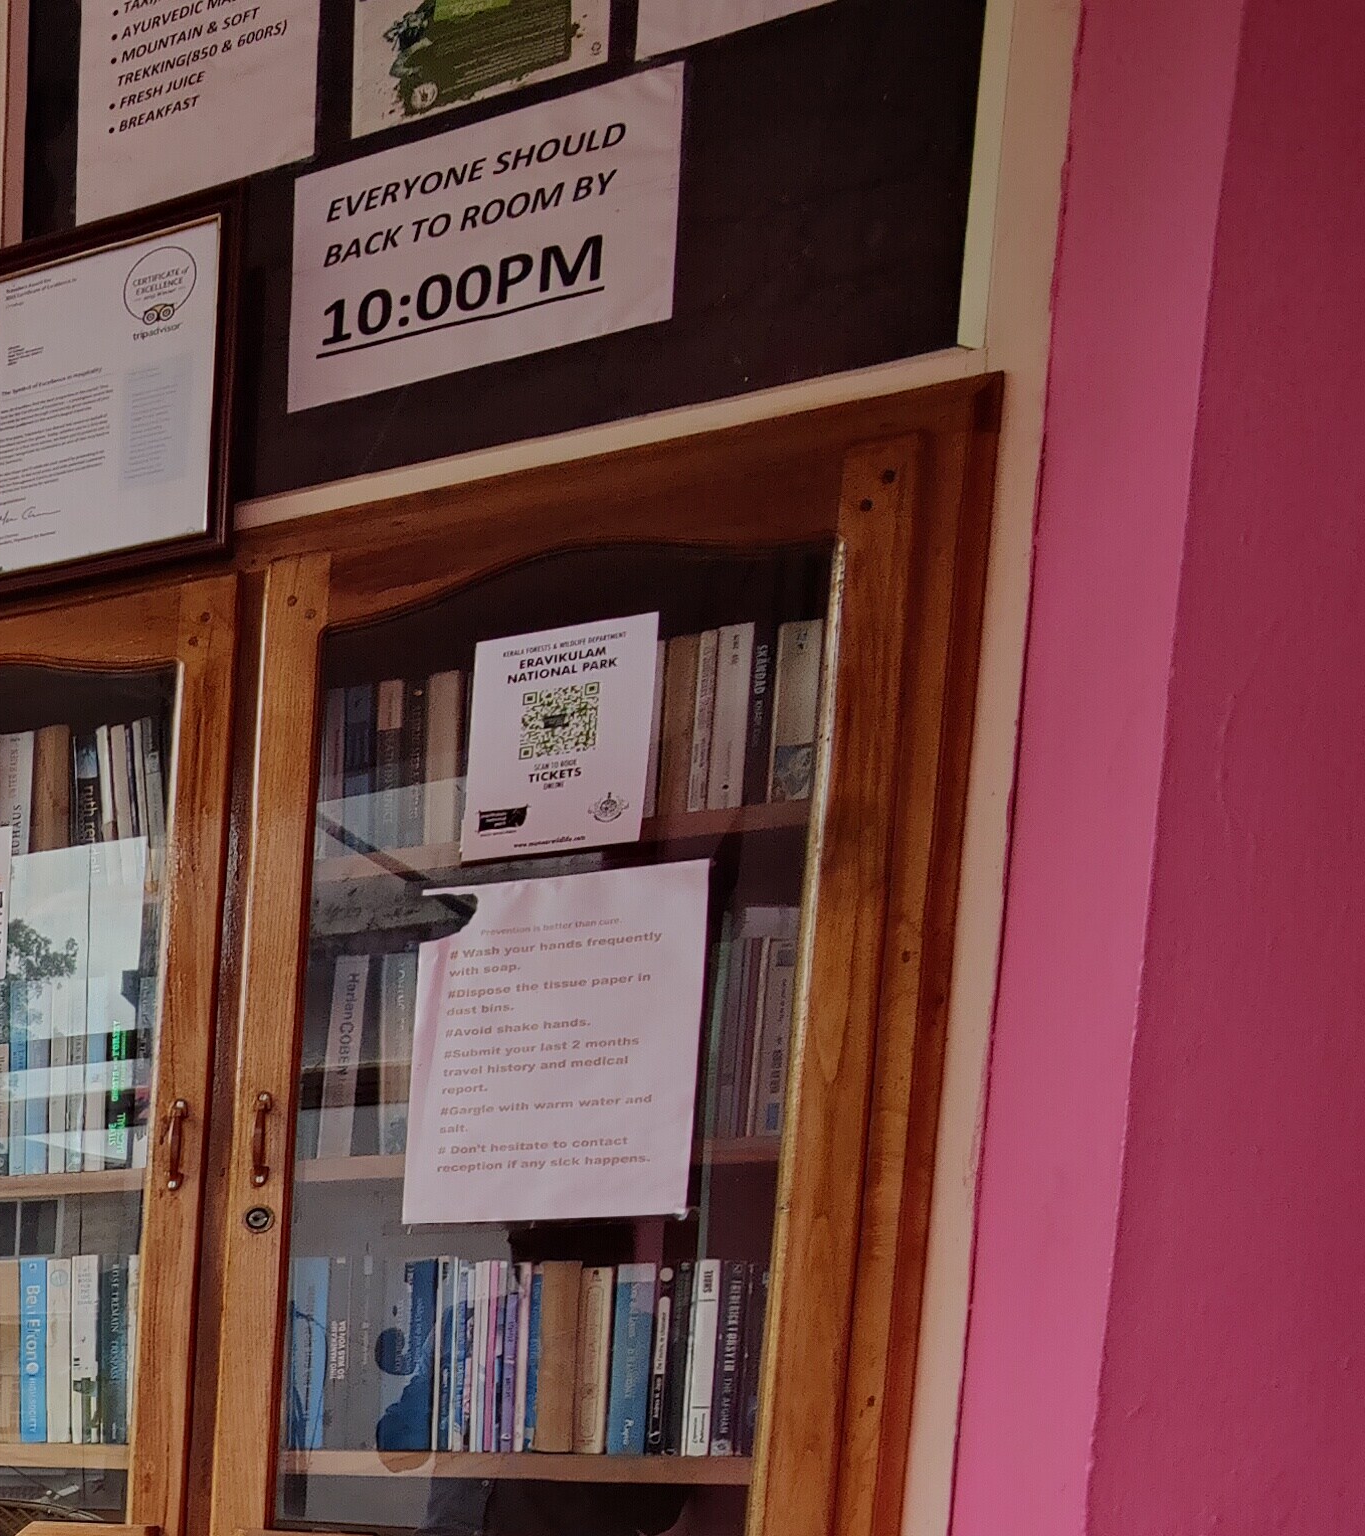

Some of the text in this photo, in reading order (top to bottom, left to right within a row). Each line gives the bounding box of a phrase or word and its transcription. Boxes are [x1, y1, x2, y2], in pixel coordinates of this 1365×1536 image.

[121, 0, 203, 40] AYURVEDIC
[121, 6, 261, 64] MOUNTAIN & SOFT
[117, 20, 288, 88] TREKKING(850 & 600RS)
[119, 70, 206, 109] FRESH JUICE
[119, 94, 201, 132] BREAKFAST
[325, 122, 627, 223] EVERYONE SHOULD
[323, 168, 617, 268] BACK TO ROOM BY
[132, 268, 181, 288] CERTIFICATE
[135, 276, 184, 296] EXCELLENCE
[321, 234, 603, 346] 10:00PM
[133, 322, 181, 341] tripadvisor
[587, 631, 627, 646] DEPARTMENT
[507, 657, 619, 684] NATIONAL PARK
[519, 646, 607, 670] ERAVIKULAM
[528, 767, 582, 784] TICKETS
[83, 784, 97, 818] ruth
[481, 926, 531, 937] Prevention
[533, 924, 541, 934] is
[543, 922, 573, 932] better
[575, 919, 597, 929] than
[463, 931, 663, 958] Wash your hands frequently
[449, 964, 521, 978] with soap.
[447, 972, 651, 1000] #Dispose the tissue paper in
[447, 1002, 515, 1016] dust bins.
[335, 972, 360, 1076] Harlan COBEN
[445, 1018, 591, 1038] #Avoid shake hands.
[444, 1036, 640, 1060] #Submit your last 2 months
[443, 1055, 629, 1078] travel history and medical
[441, 1082, 489, 1096] report.
[439, 1094, 653, 1117] #Gargle with warm water and
[439, 1124, 469, 1135] salt.
[451, 1136, 629, 1156] Don't hesitate to contact
[437, 1154, 651, 1174] reception if any sick happens.
[111, 1264, 119, 1333] ROSE TREMAIN
[25, 1318, 41, 1360] Elton
[337, 1320, 347, 1380] SO WAS VON DA
[718, 1280, 742, 1434] FREDERICK FORSYTH AFGHAN
